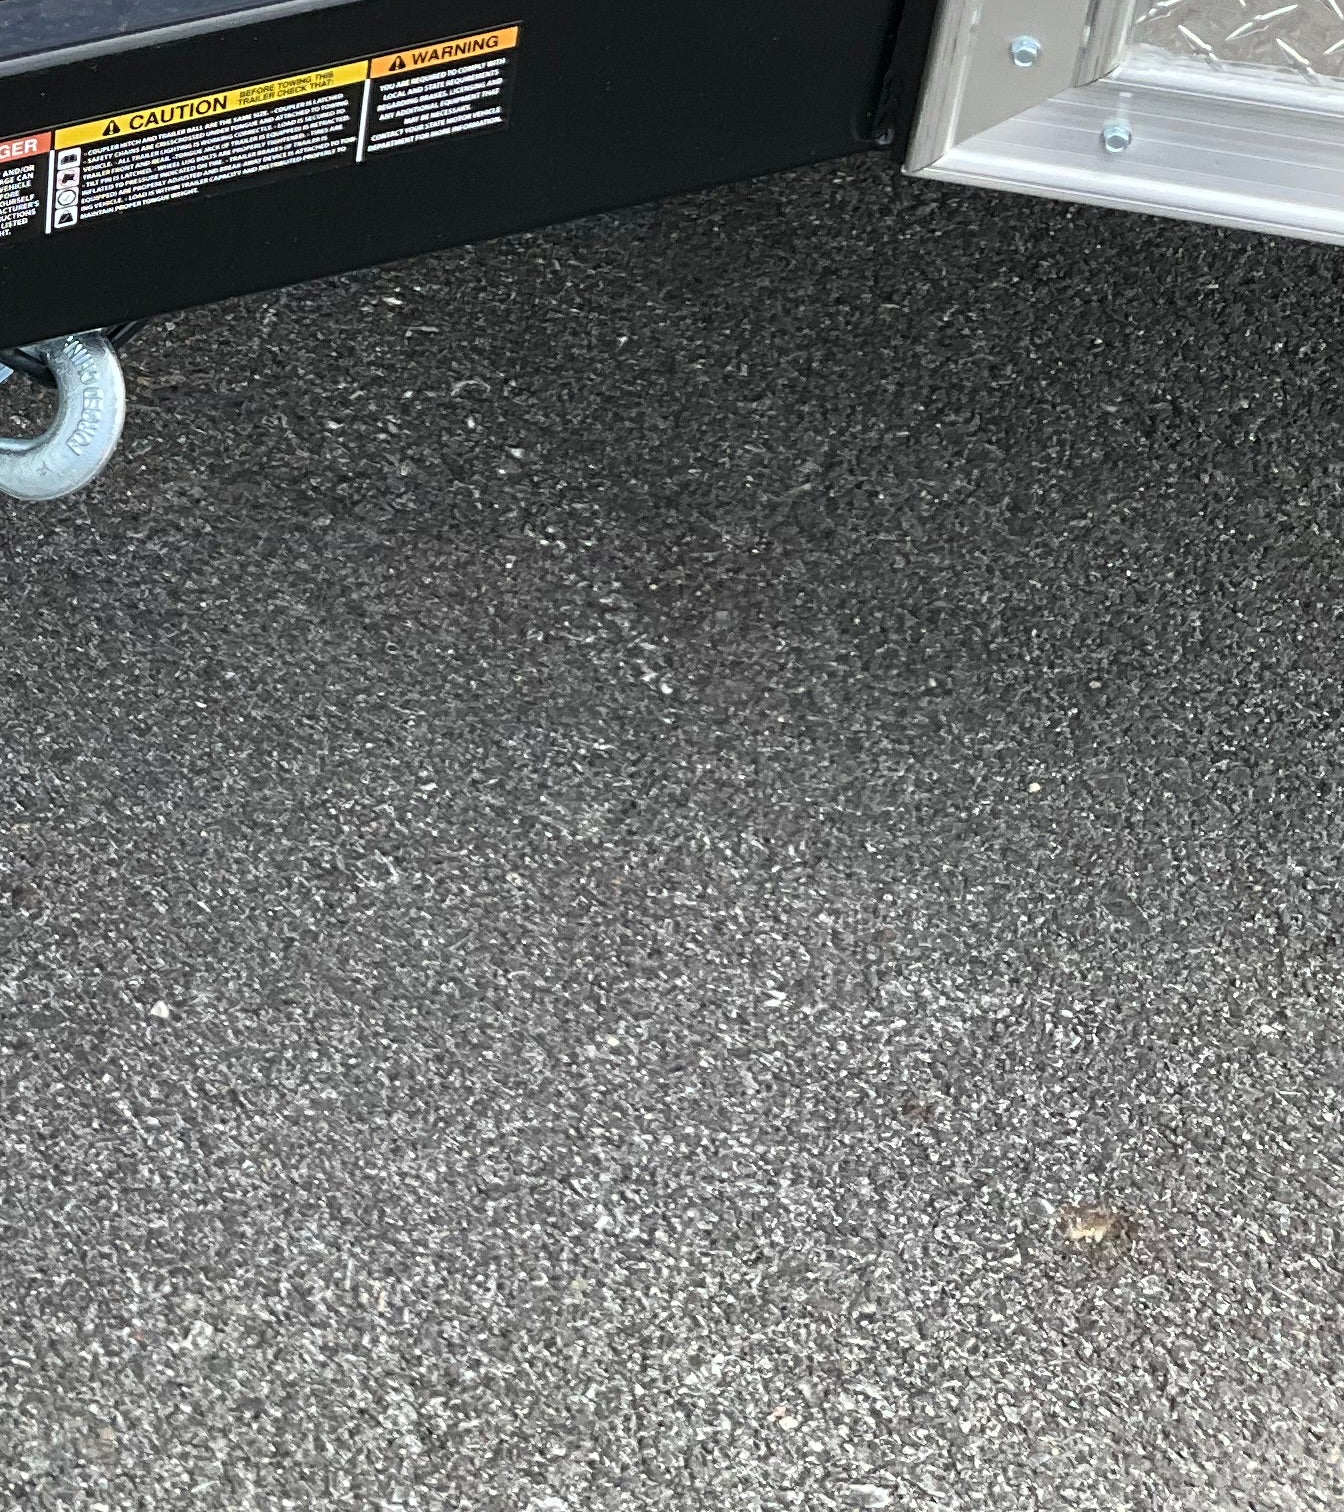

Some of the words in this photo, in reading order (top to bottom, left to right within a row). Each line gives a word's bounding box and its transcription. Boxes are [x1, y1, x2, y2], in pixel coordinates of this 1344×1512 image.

[412, 36, 499, 65] WARNING
[239, 85, 273, 98] BEFORE
[277, 76, 311, 89] TOWING
[315, 71, 334, 80] THIS
[238, 92, 274, 105] TRAILER
[277, 85, 306, 96] CHECK
[129, 95, 227, 130] CAUTION
[2, 164, 34, 177] AND/OR
[16, 172, 33, 181] CAN
[0, 218, 28, 229] LISTED
